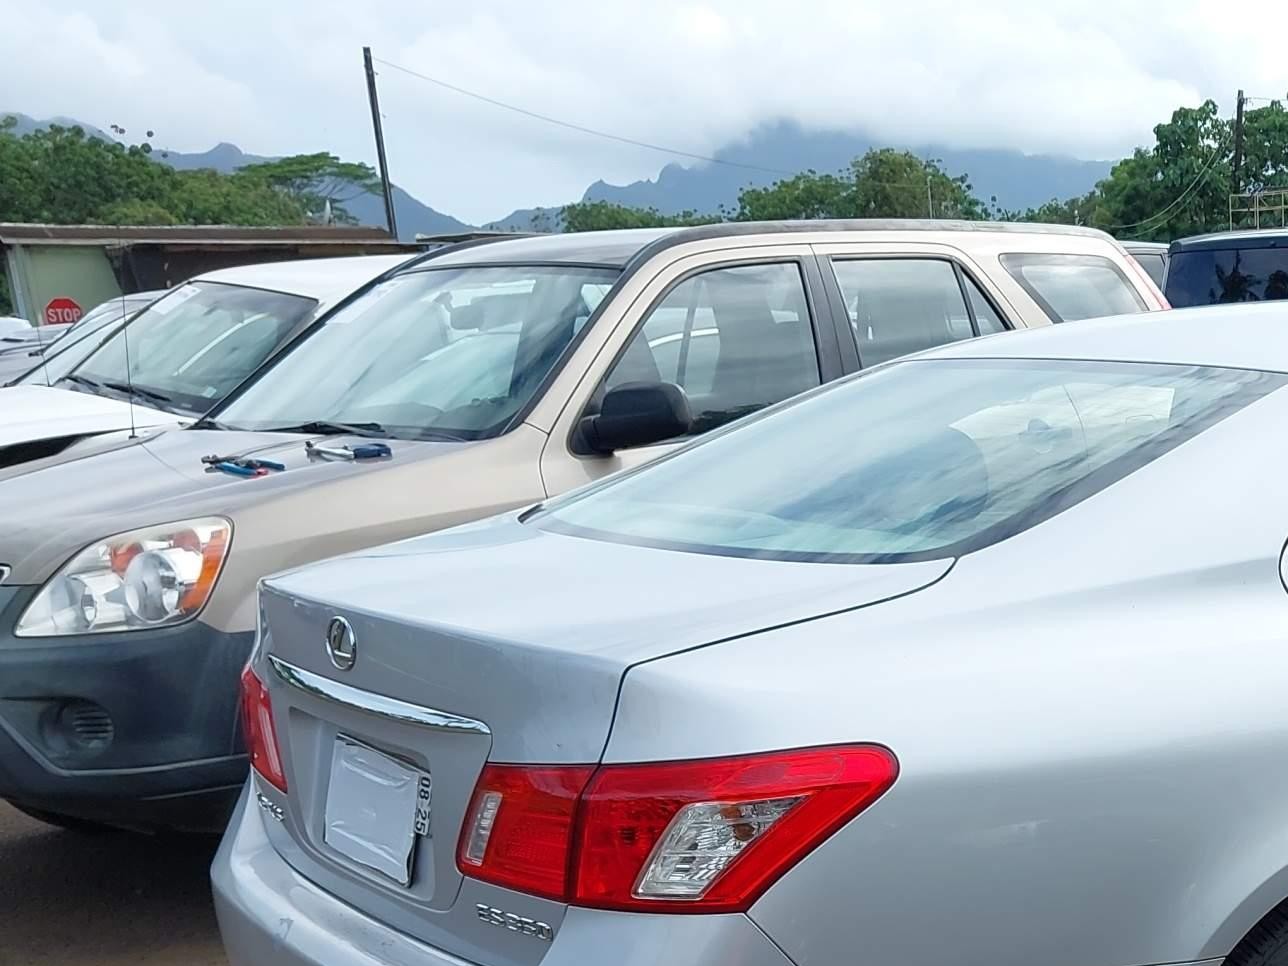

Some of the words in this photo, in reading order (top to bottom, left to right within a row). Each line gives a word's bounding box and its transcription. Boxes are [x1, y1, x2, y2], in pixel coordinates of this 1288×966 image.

[47, 307, 81, 322] STOP
[420, 776, 431, 801] 08
[415, 808, 428, 834] 25
